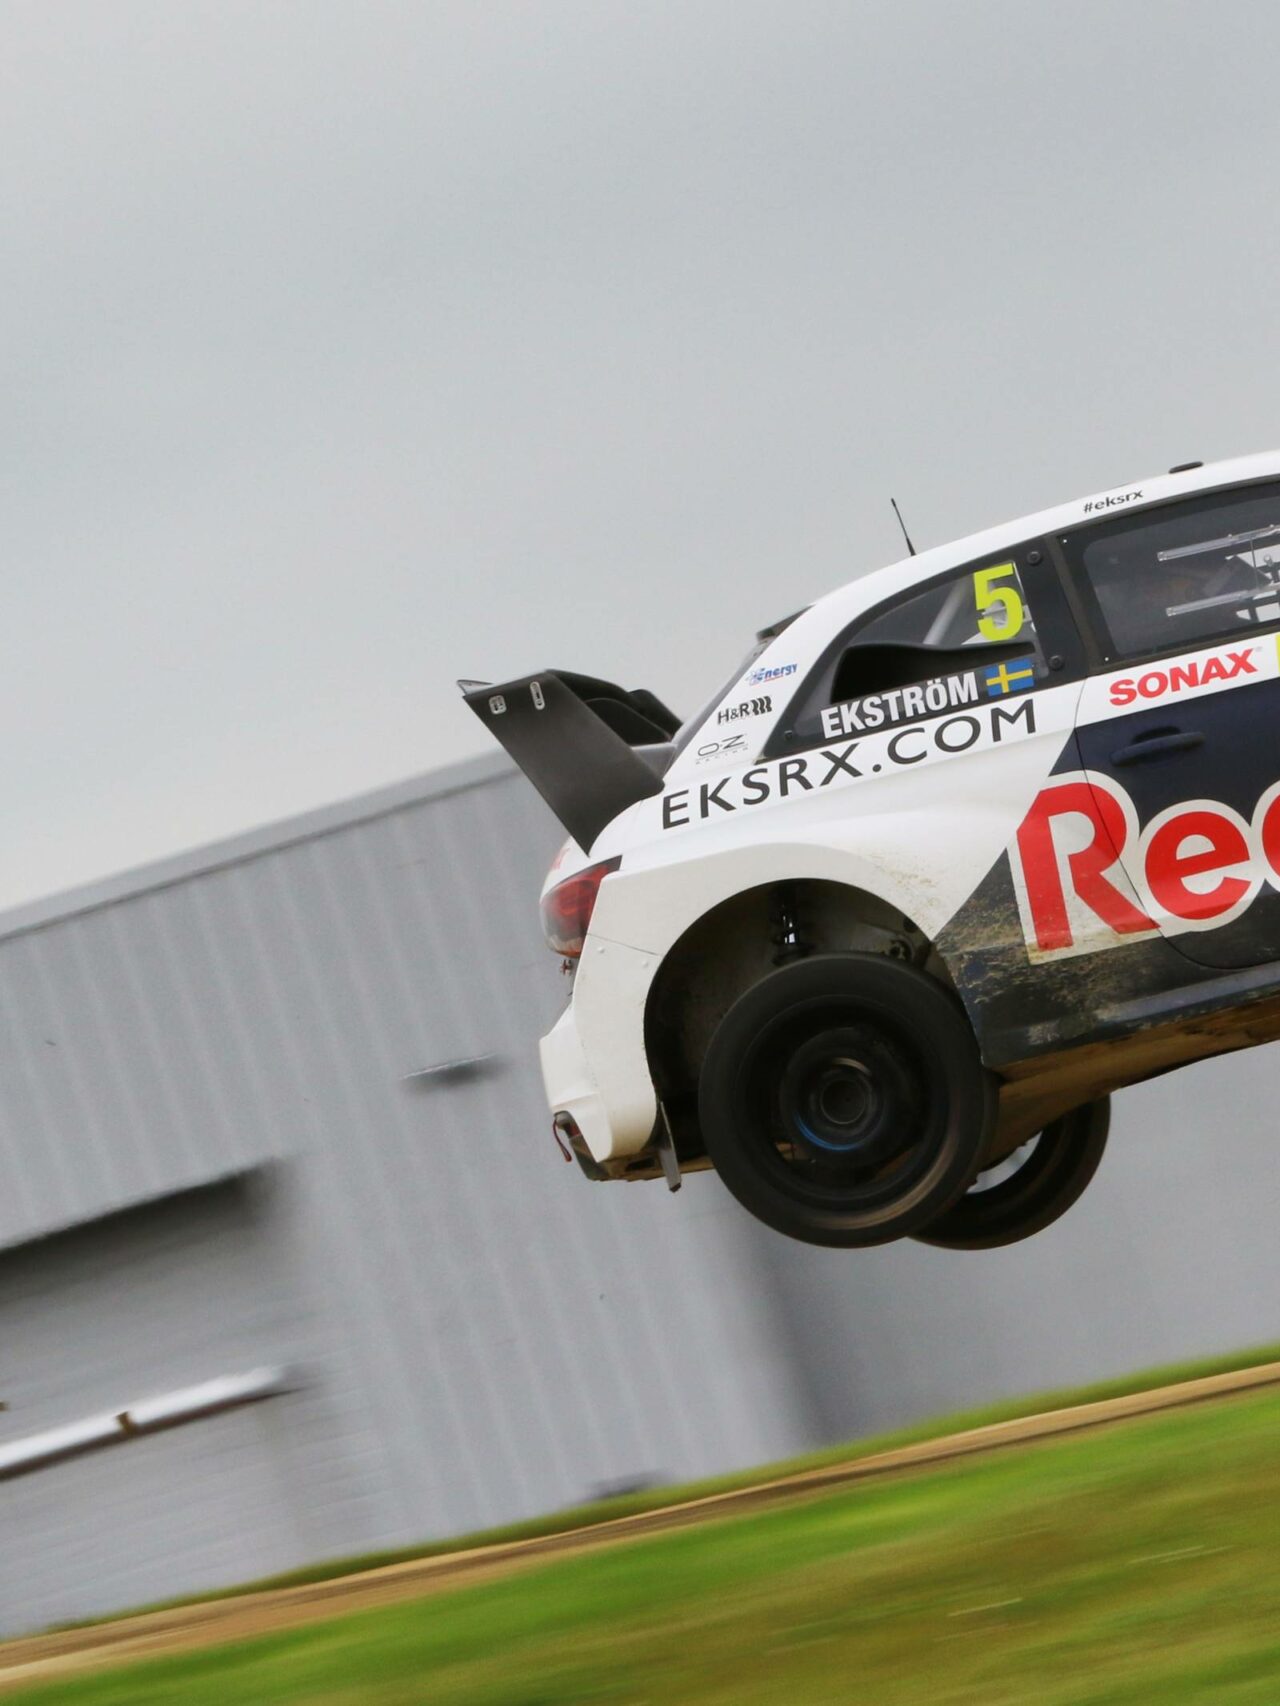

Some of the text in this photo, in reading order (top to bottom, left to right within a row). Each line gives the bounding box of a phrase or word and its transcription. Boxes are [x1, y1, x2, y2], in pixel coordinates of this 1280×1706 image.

[1083, 489, 1144, 514] #eksrx
[973, 562, 1024, 641] 5
[820, 672, 979, 740] EKSTRÖM
[1109, 649, 1259, 706] SONAX
[717, 702, 751, 724] H&R
[661, 699, 1035, 830] EKSRX.COM
